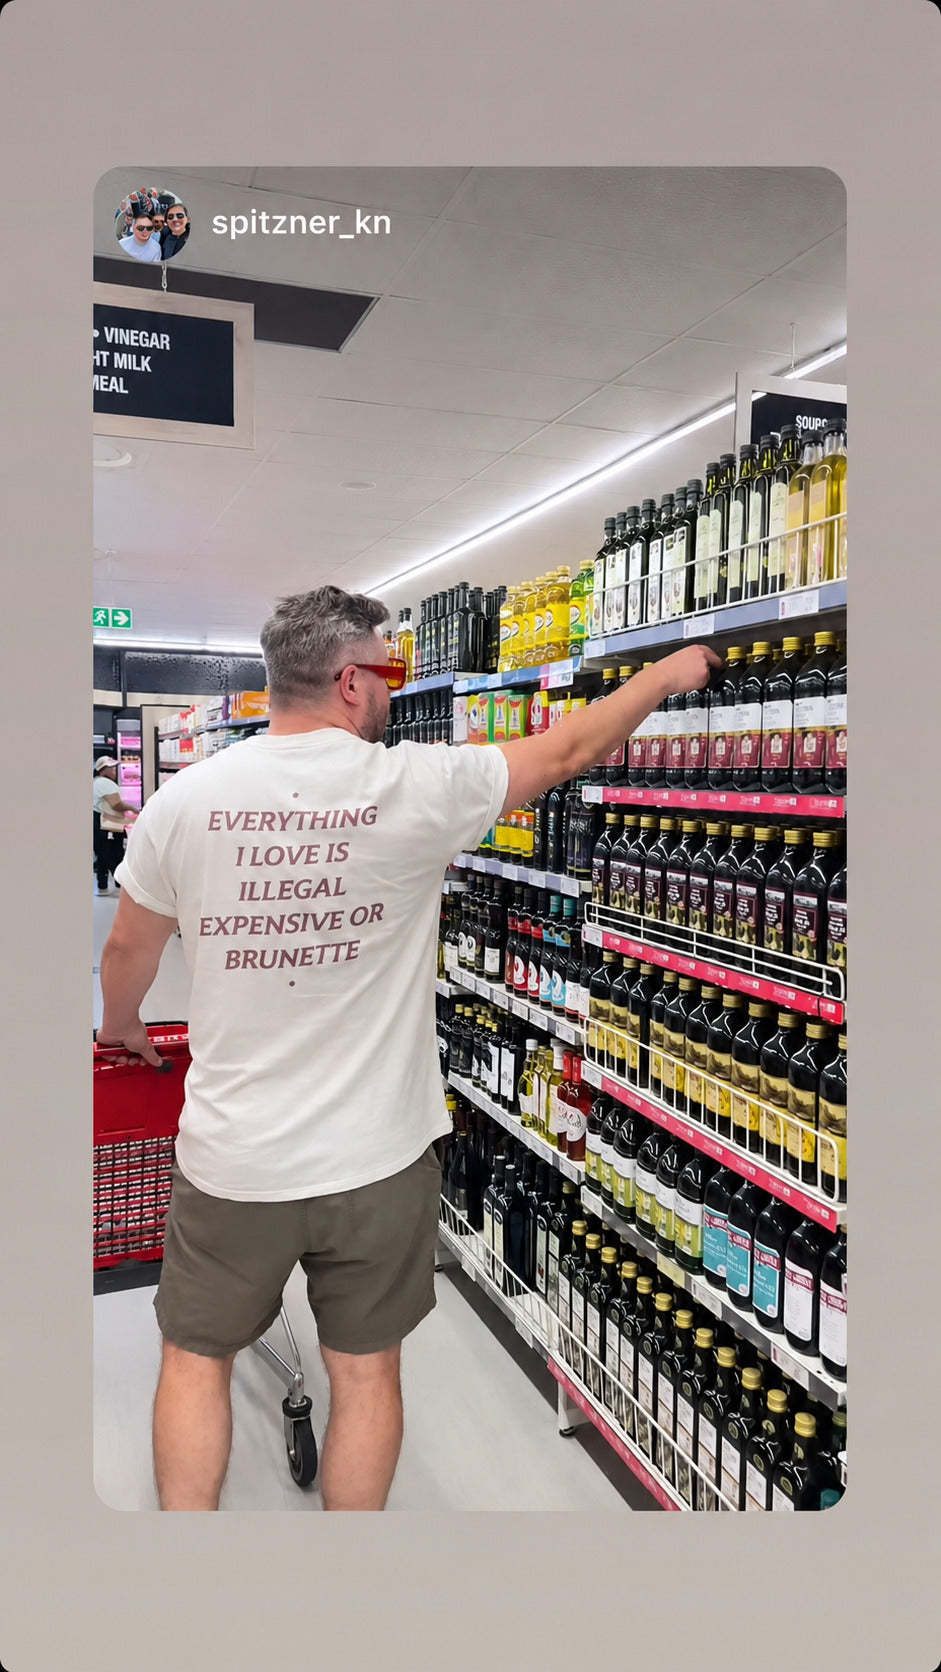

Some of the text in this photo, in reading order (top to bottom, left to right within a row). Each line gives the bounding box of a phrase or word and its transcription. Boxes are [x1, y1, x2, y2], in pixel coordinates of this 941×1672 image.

[104, 326, 171, 351] VINEGAR
[114, 352, 152, 373] MILK
[207, 805, 378, 832] EVERYTHING
[235, 841, 350, 867] I LOVE IS
[238, 876, 347, 902] ILLEGAL
[199, 902, 385, 936] EXPENSIVE OR
[224, 939, 361, 970] BRUNETTE
